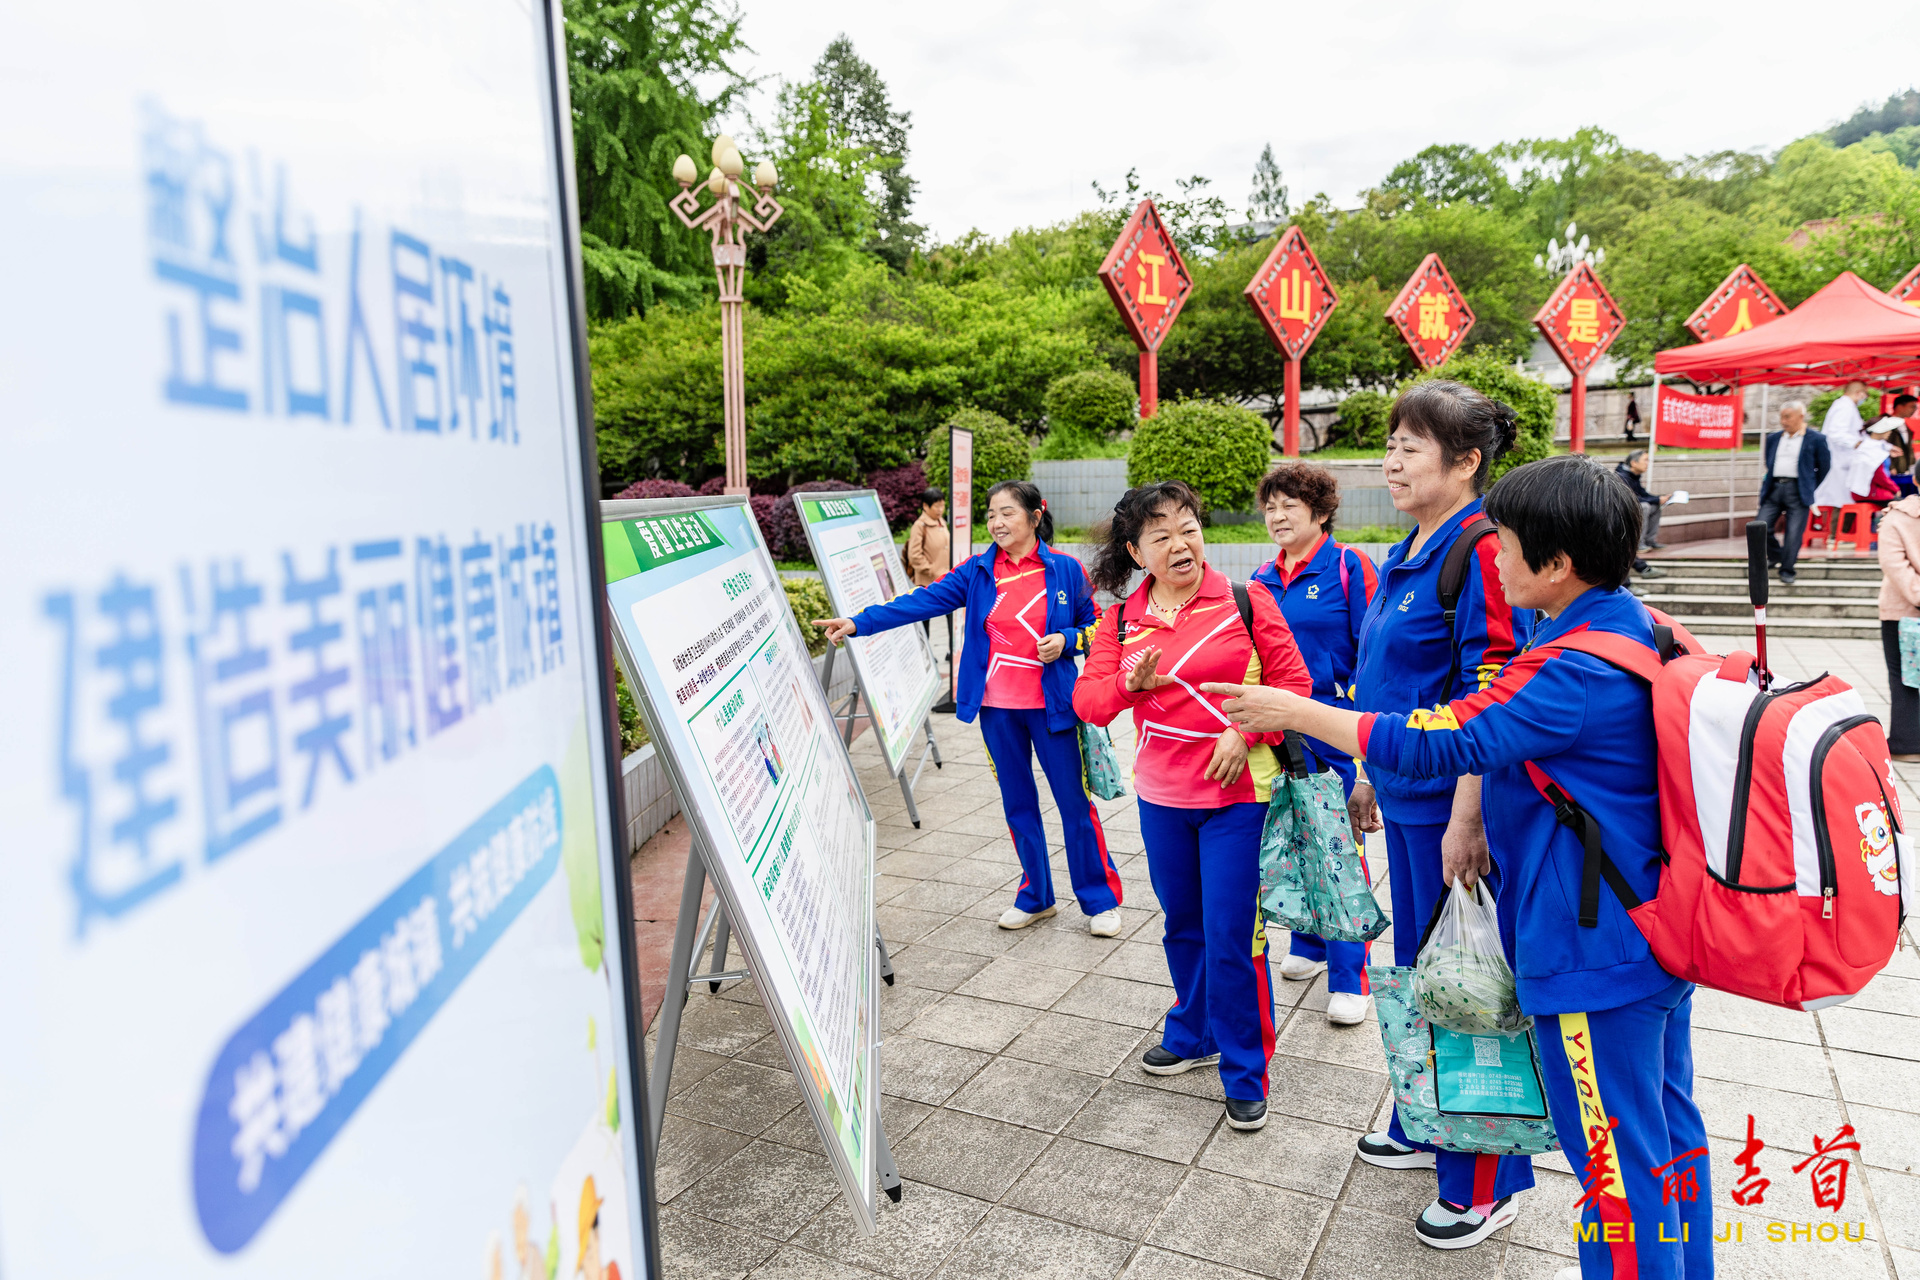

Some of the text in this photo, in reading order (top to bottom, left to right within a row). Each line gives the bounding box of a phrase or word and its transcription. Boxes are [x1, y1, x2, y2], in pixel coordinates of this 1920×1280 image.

[138, 96, 522, 445] 整治人居环境
[1136, 248, 1168, 306] 江
[1279, 267, 1312, 325] 山
[1417, 290, 1451, 342] 就
[1566, 297, 1601, 344] 是
[634, 514, 711, 560] 爱国卫生运动
